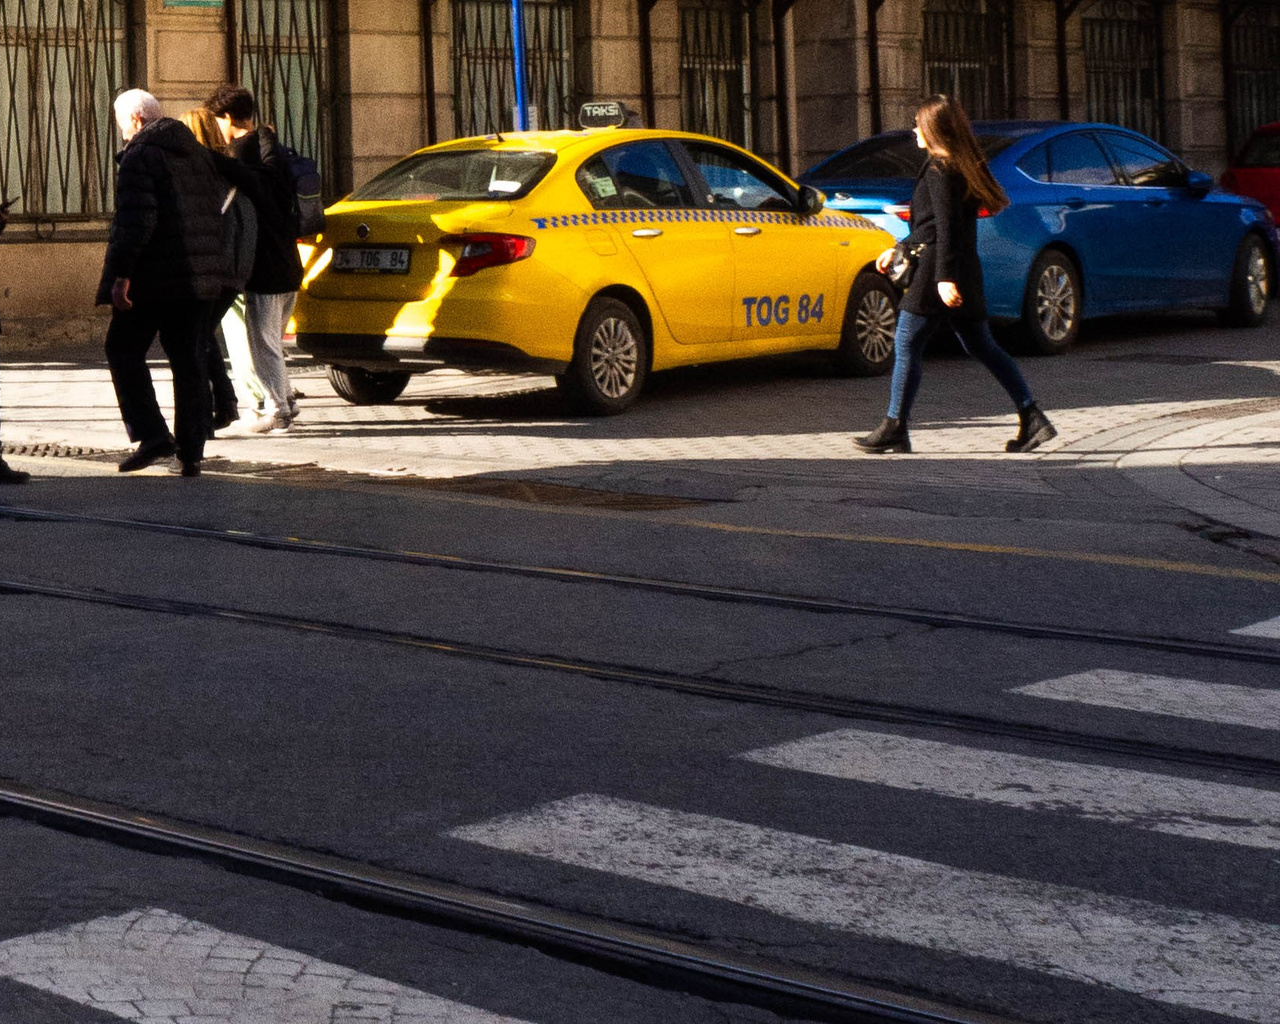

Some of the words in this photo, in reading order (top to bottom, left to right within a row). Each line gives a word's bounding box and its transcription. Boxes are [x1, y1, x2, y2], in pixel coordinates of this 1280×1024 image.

[390, 251, 406, 268] 84
[742, 295, 790, 327] TOG
[797, 293, 824, 325] 84
